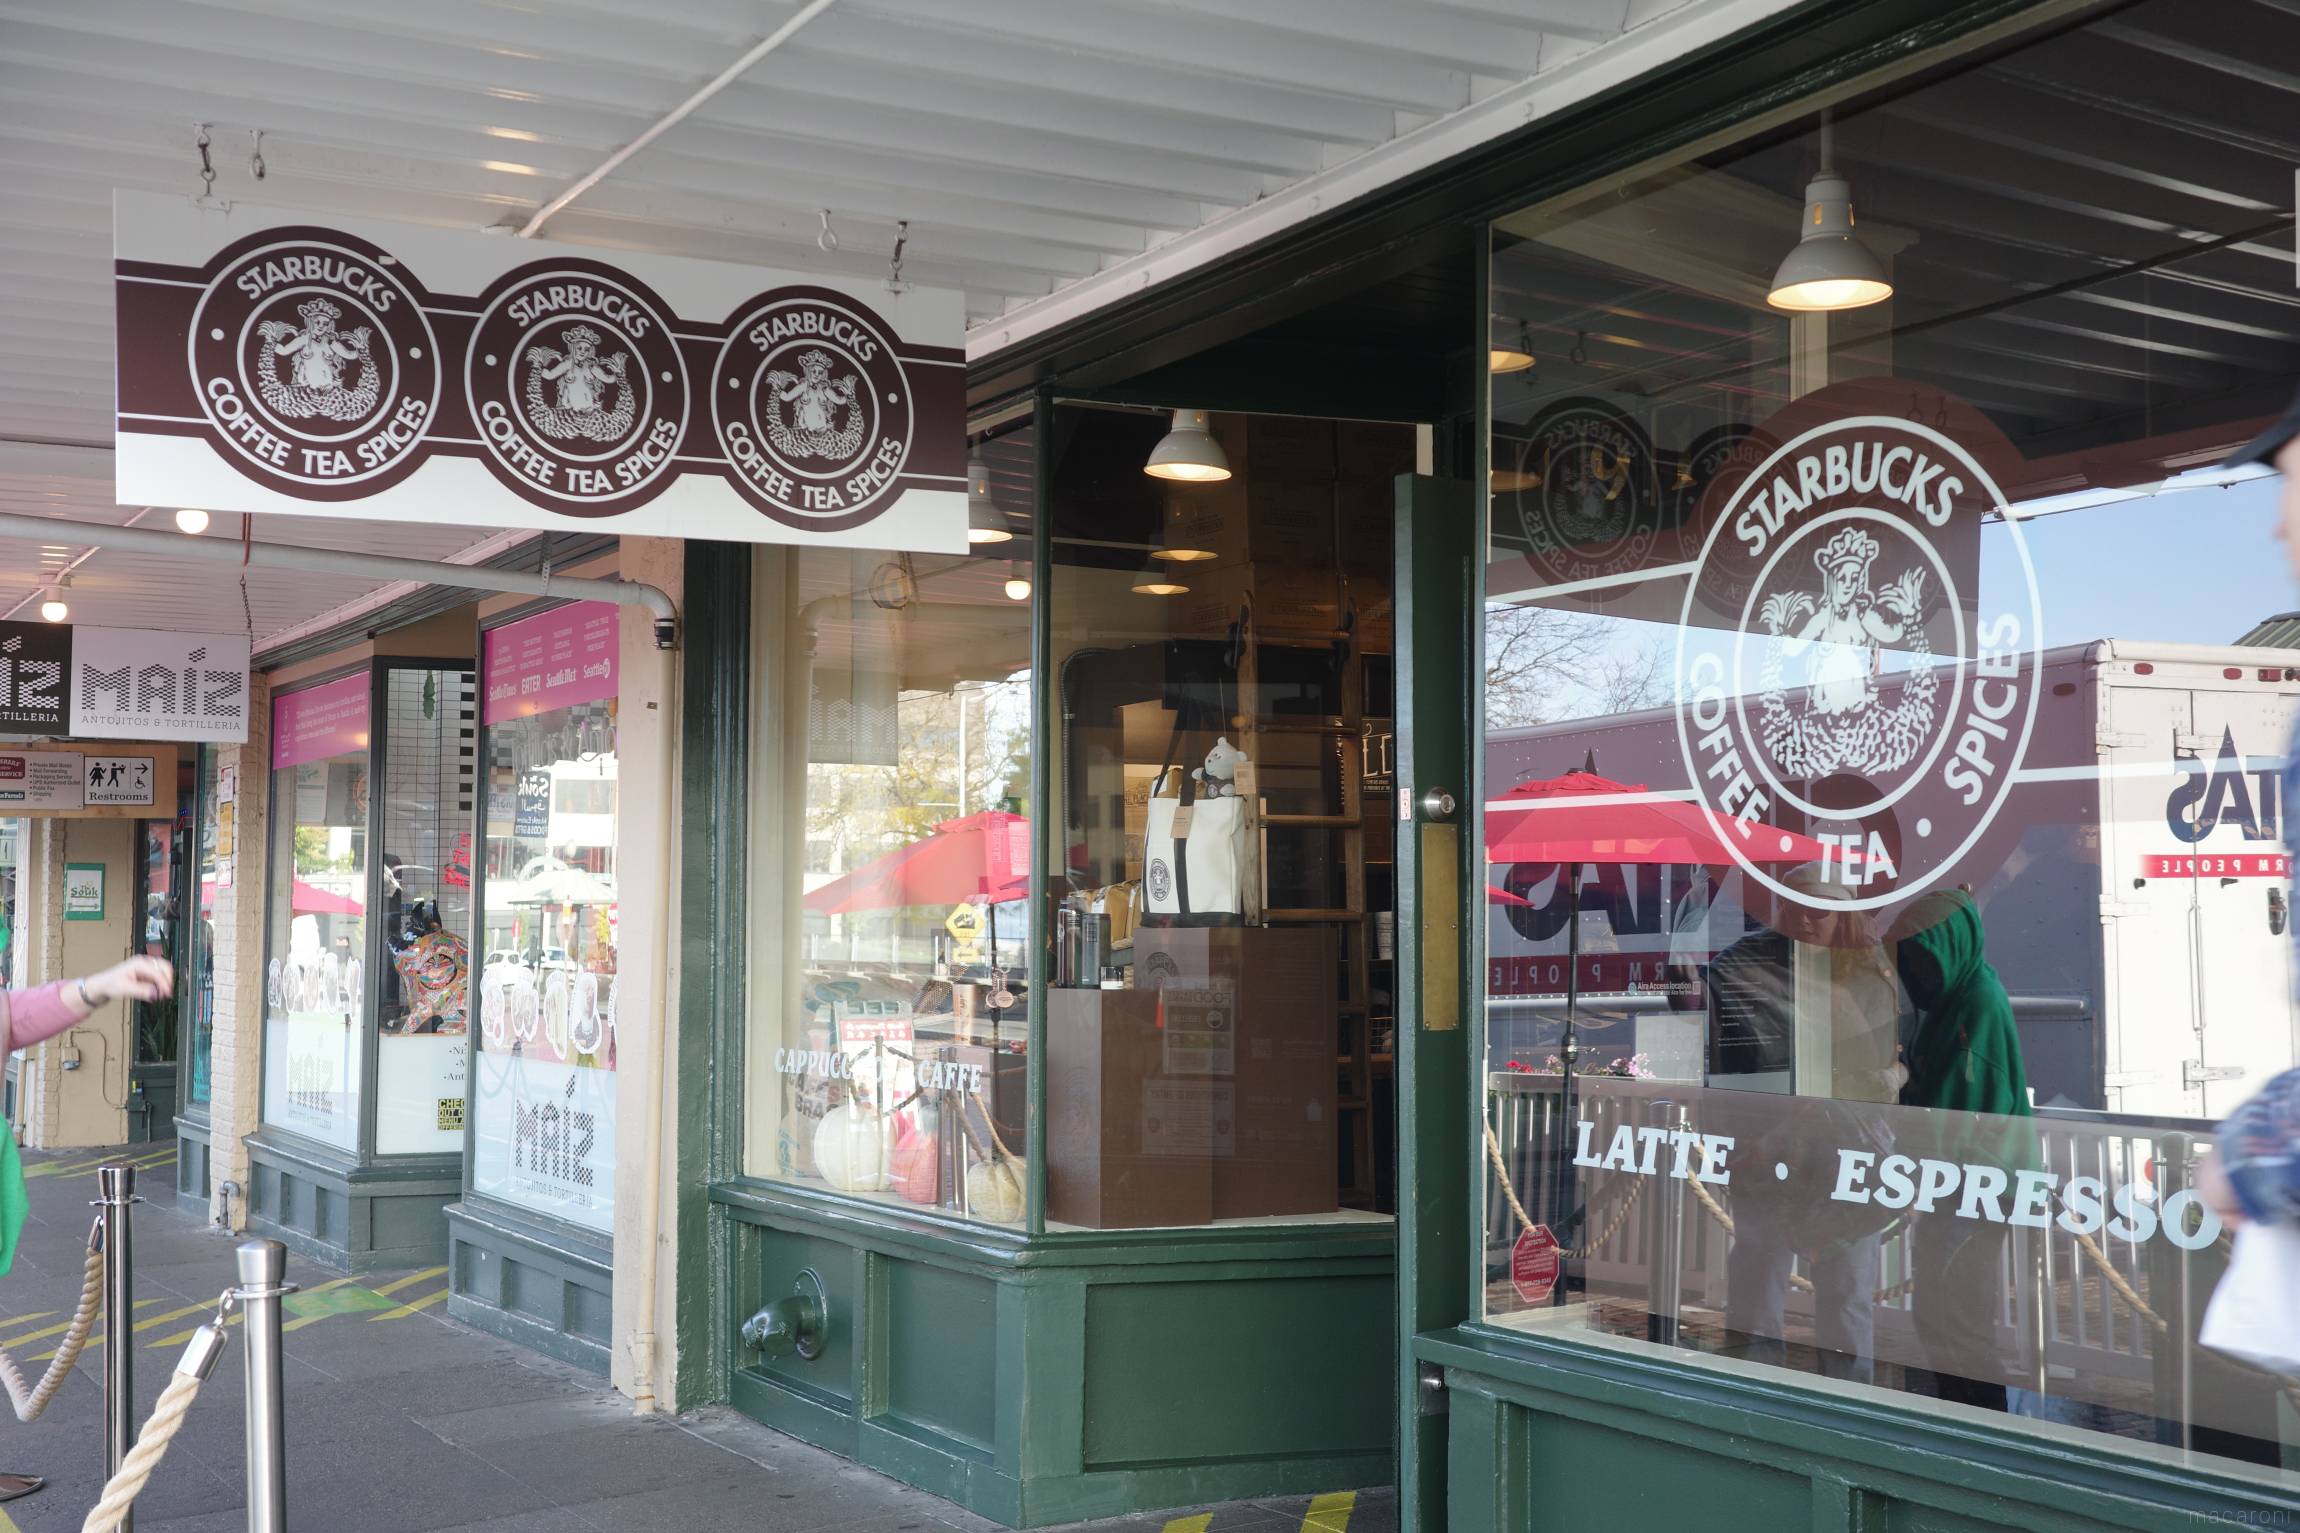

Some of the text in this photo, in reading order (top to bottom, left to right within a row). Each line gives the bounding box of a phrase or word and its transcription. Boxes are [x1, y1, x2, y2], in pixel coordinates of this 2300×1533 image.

[236, 255, 397, 312] STARBUCKS
[508, 285, 650, 338] STARBUCKS
[750, 311, 877, 361] STARBUCKS
[208, 377, 427, 475] COFFEE TEA SPICES
[482, 400, 677, 493] COFFEE TEA SPICES
[726, 421, 902, 509] COFFEE TEA SPICES
[1735, 441, 1963, 556] STARBUCKS
[82, 647, 242, 716] MAÍZ
[0, 711, 59, 722] TILLERIA
[82, 715, 241, 730] ANTOJITOS & TORTILLERIA
[1691, 611, 2020, 886] COFFEE TEA SPICES
[89, 791, 149, 801] Restrooms
[71, 887, 98, 897] Souk
[1650, 982, 1669, 990] Access
[1670, 981, 1691, 990] location
[774, 1047, 983, 1093] CAPPUCCO CAFFE
[516, 1074, 594, 1187] MAÍZ
[1572, 1120, 2223, 1250] LATTE ESPRESSO
